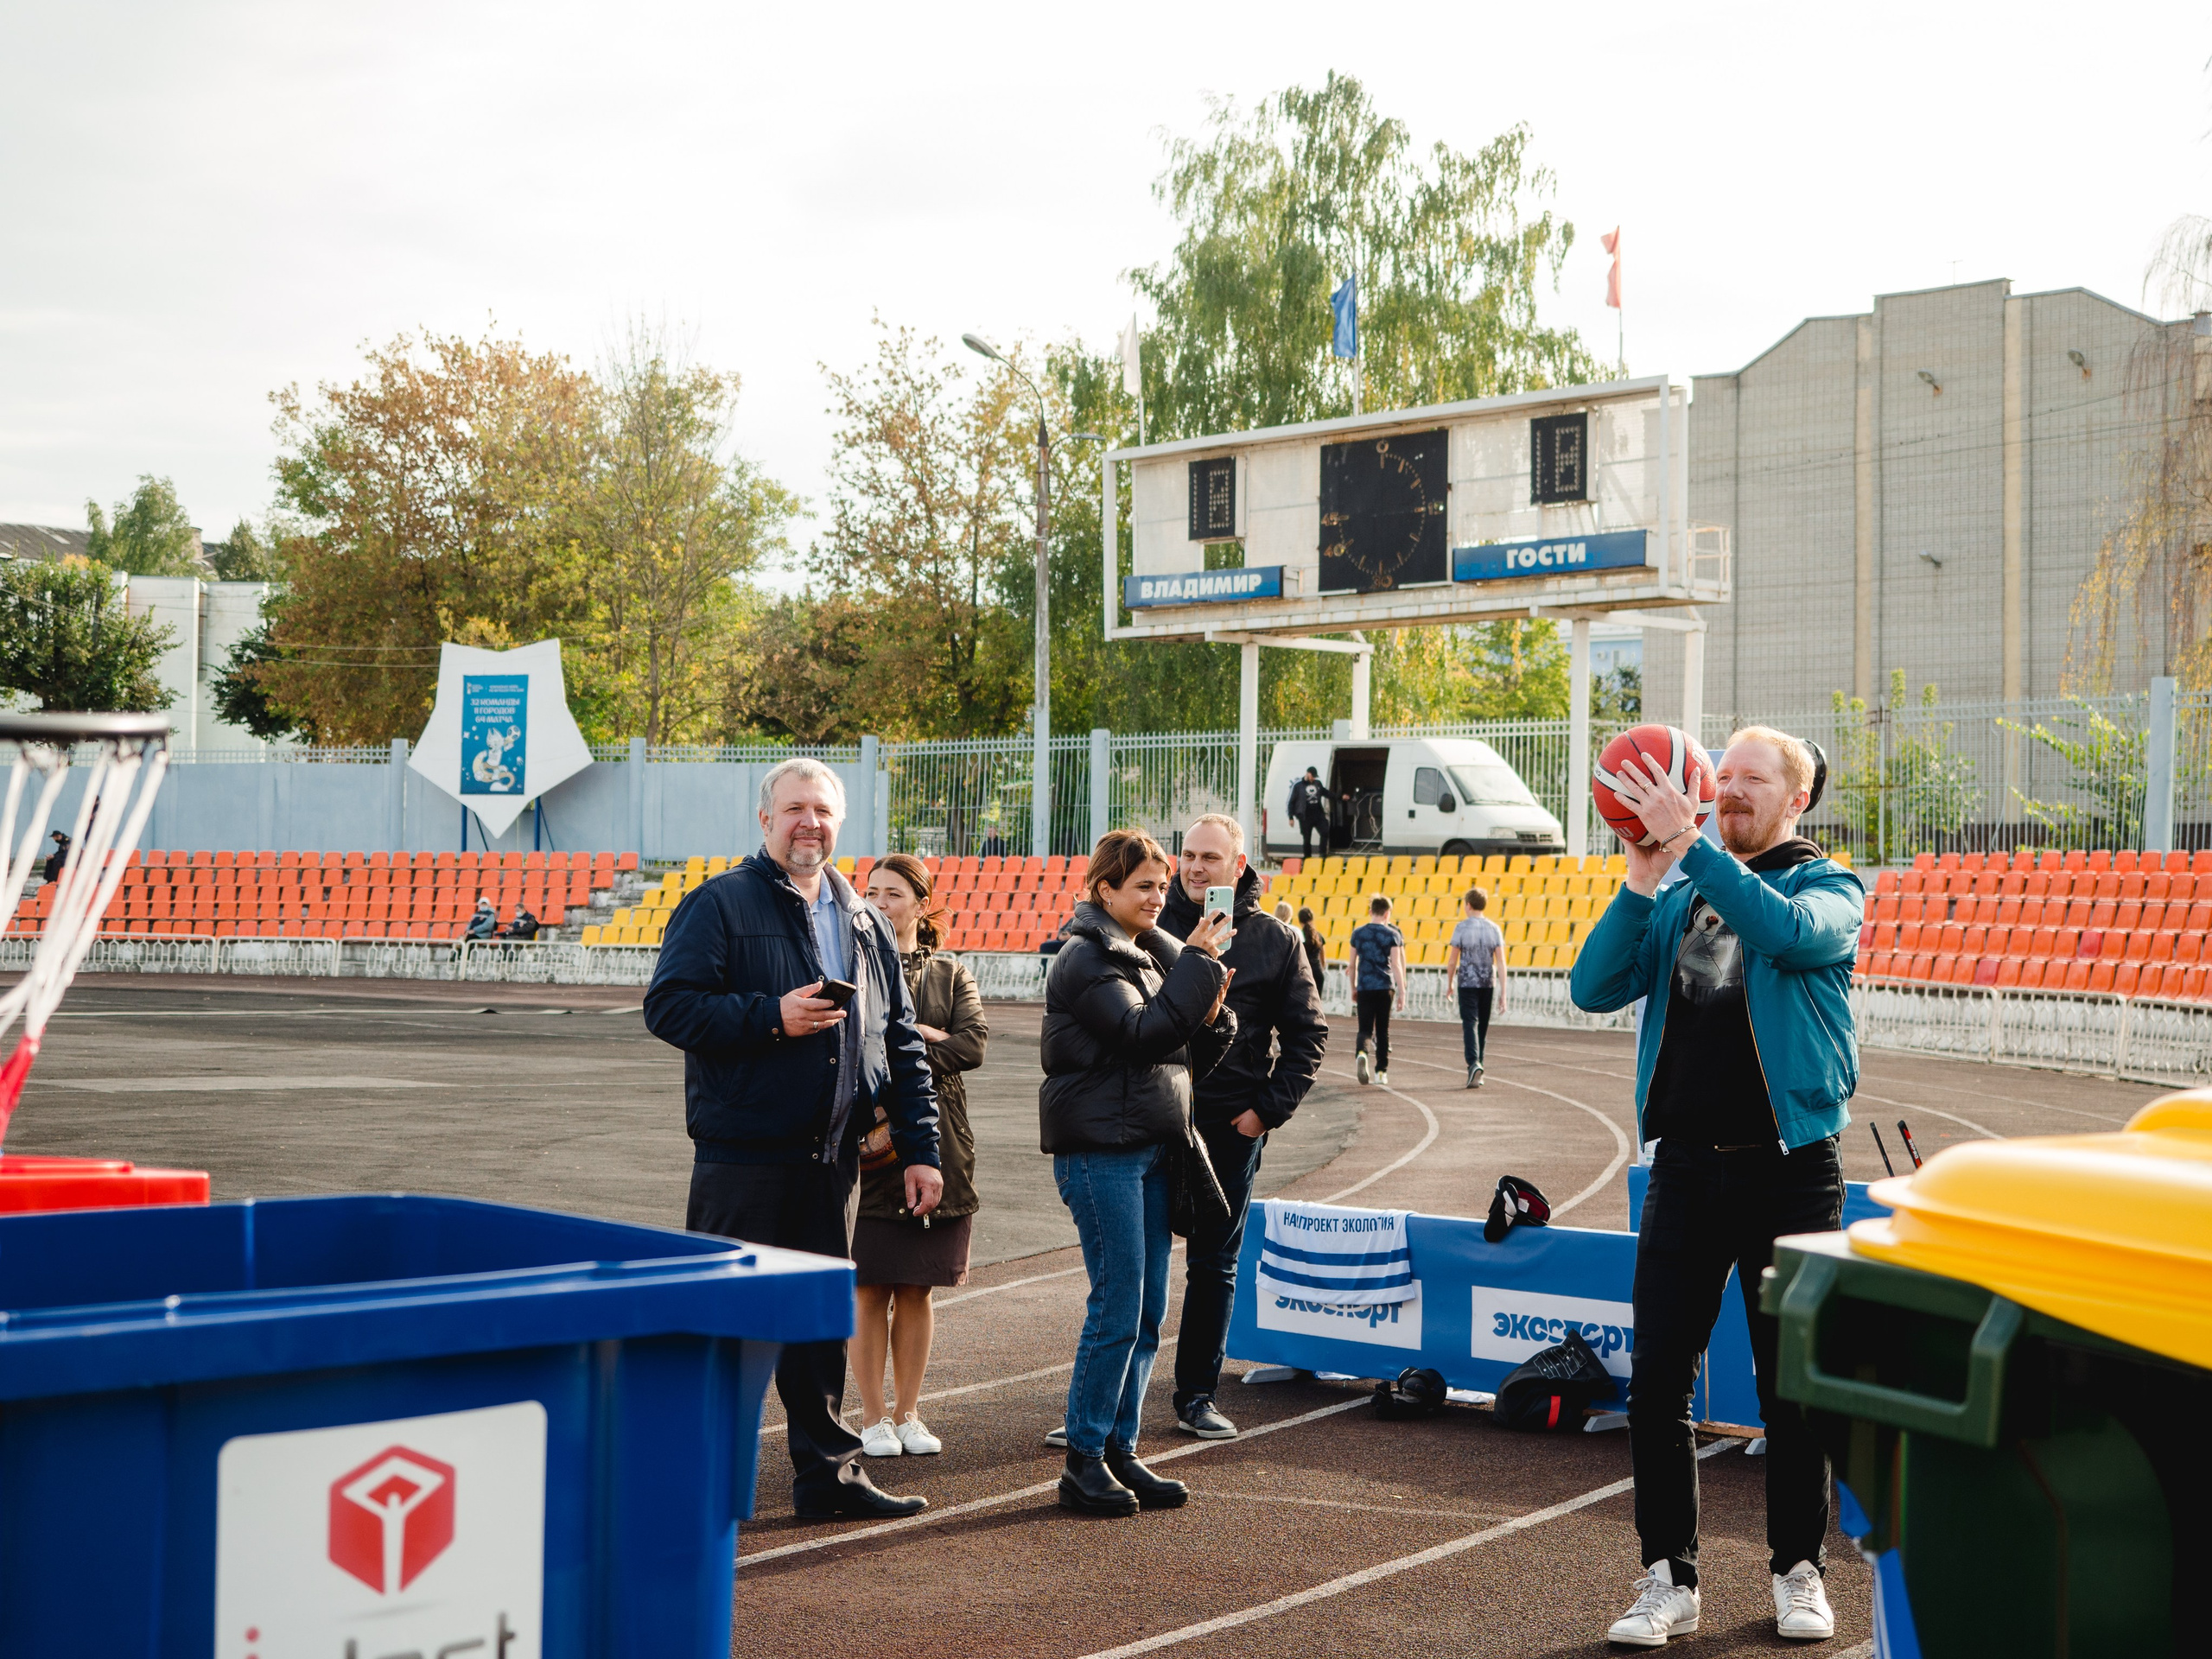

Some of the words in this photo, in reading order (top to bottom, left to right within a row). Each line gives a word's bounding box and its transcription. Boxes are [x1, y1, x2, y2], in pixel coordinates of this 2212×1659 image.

[1323, 543, 1345, 557] 40
[1506, 543, 1586, 569] ГОСТИ
[1141, 574, 1262, 599] ВЛАДИМИР
[480, 707, 516, 715] ГОРОДОВ
[1284, 1211, 1339, 1232] НАПРОЕКТ
